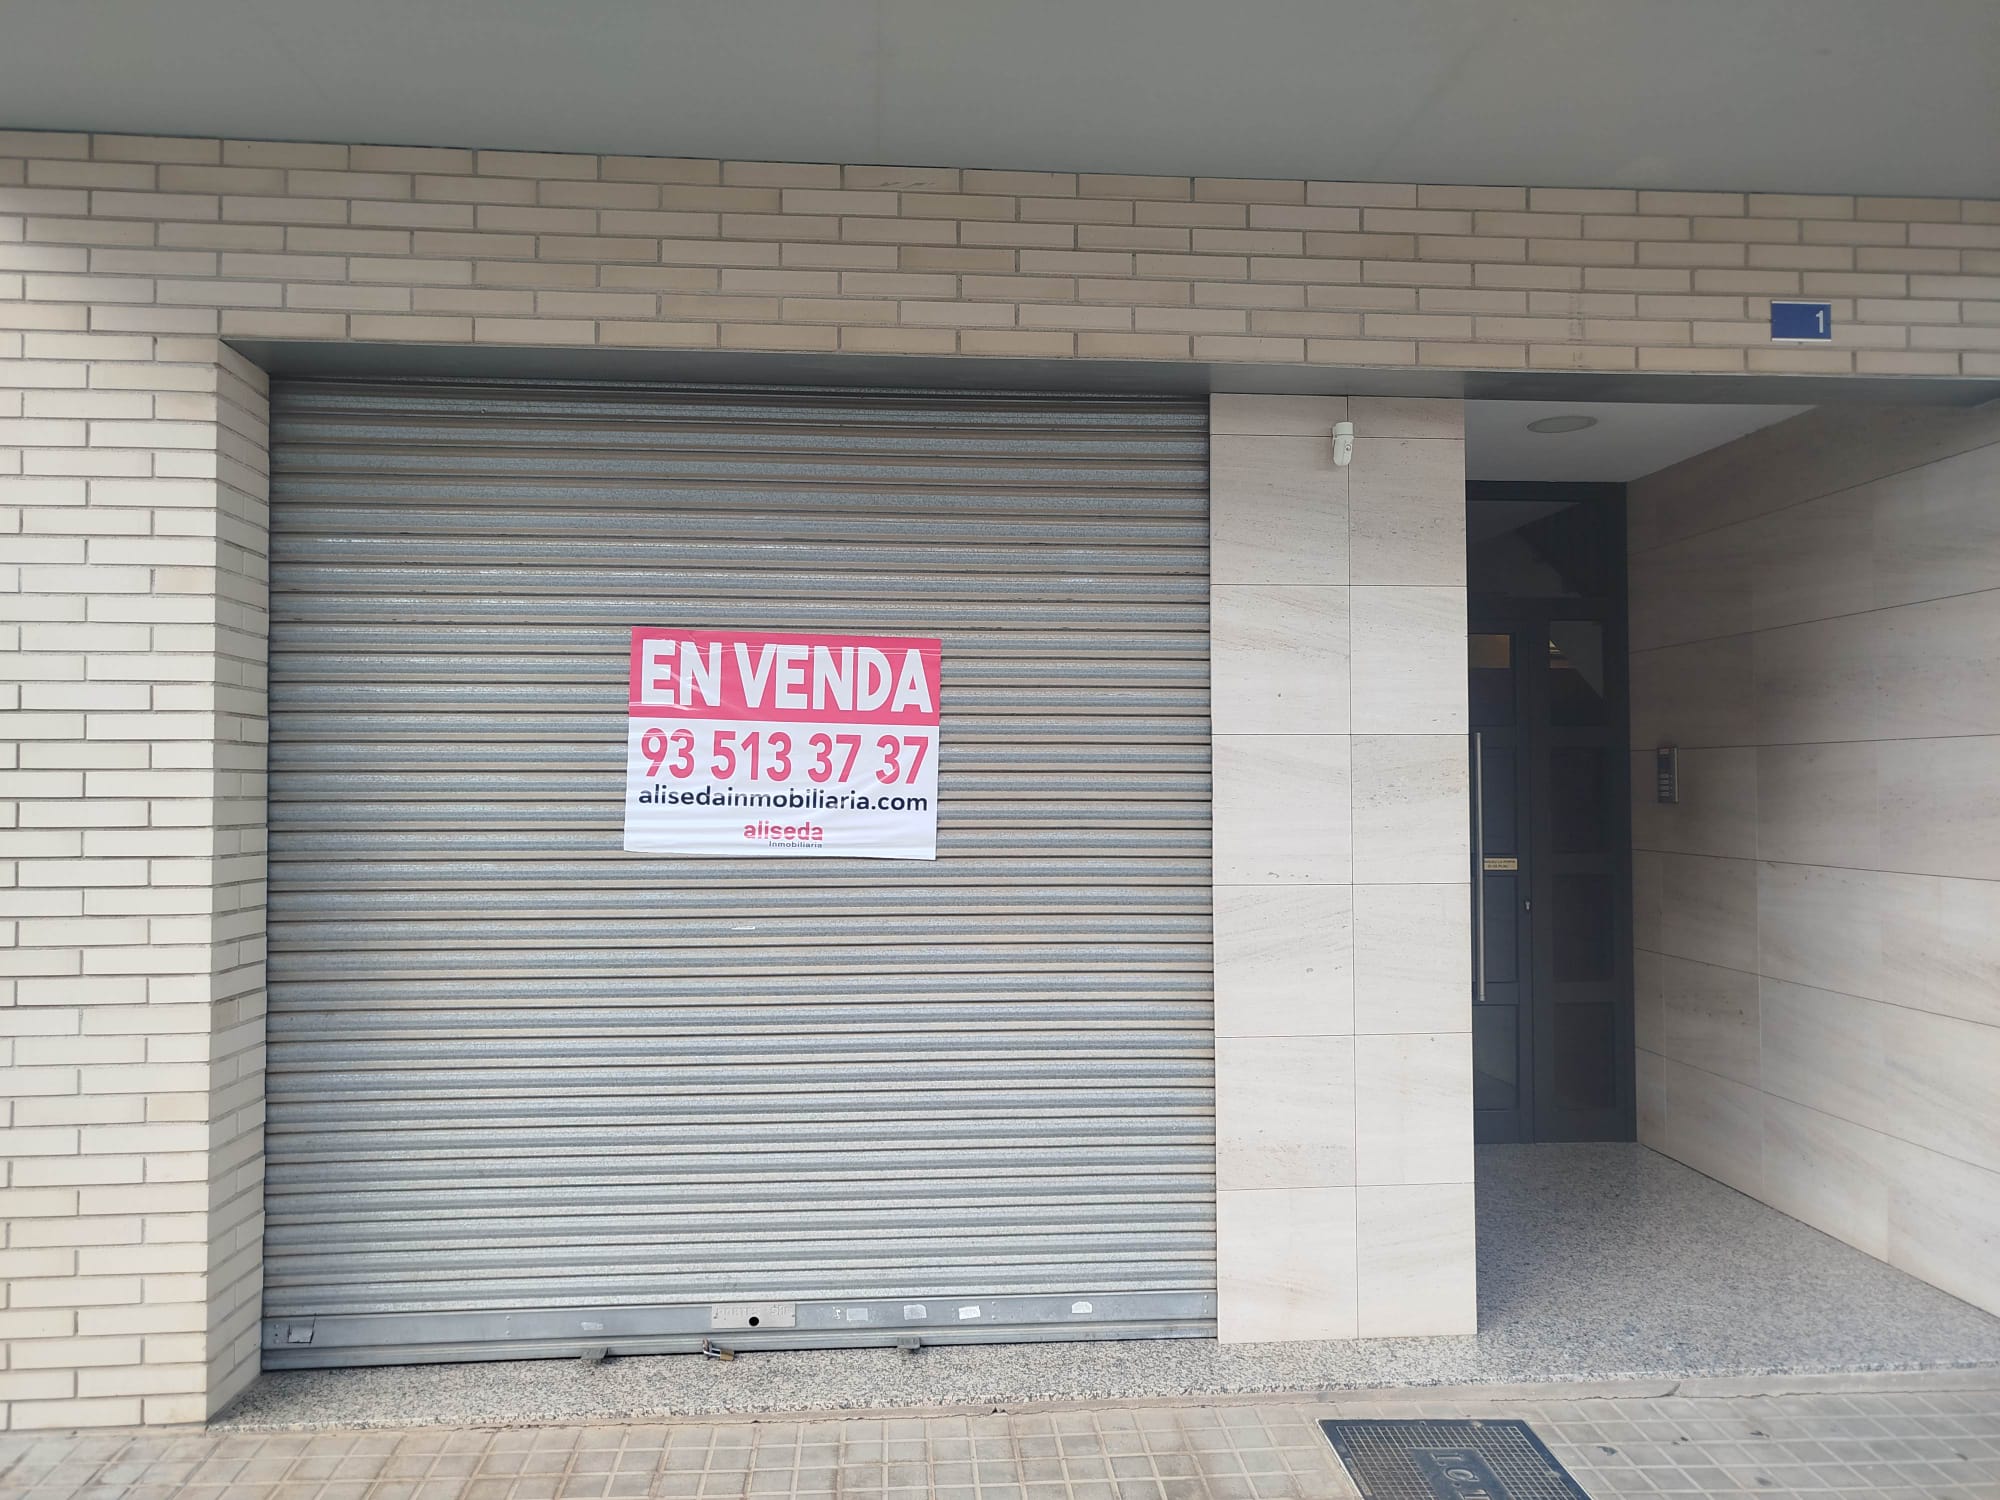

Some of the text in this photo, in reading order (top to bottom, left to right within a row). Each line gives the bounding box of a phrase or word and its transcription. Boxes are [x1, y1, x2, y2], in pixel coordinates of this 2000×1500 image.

[1815, 310, 1824, 333] 1
[642, 639, 933, 713] EN VENDA
[641, 727, 929, 784] 93 513 37 37
[638, 784, 928, 811] alisedainmobiliaria.com
[743, 820, 823, 841] aliseda
